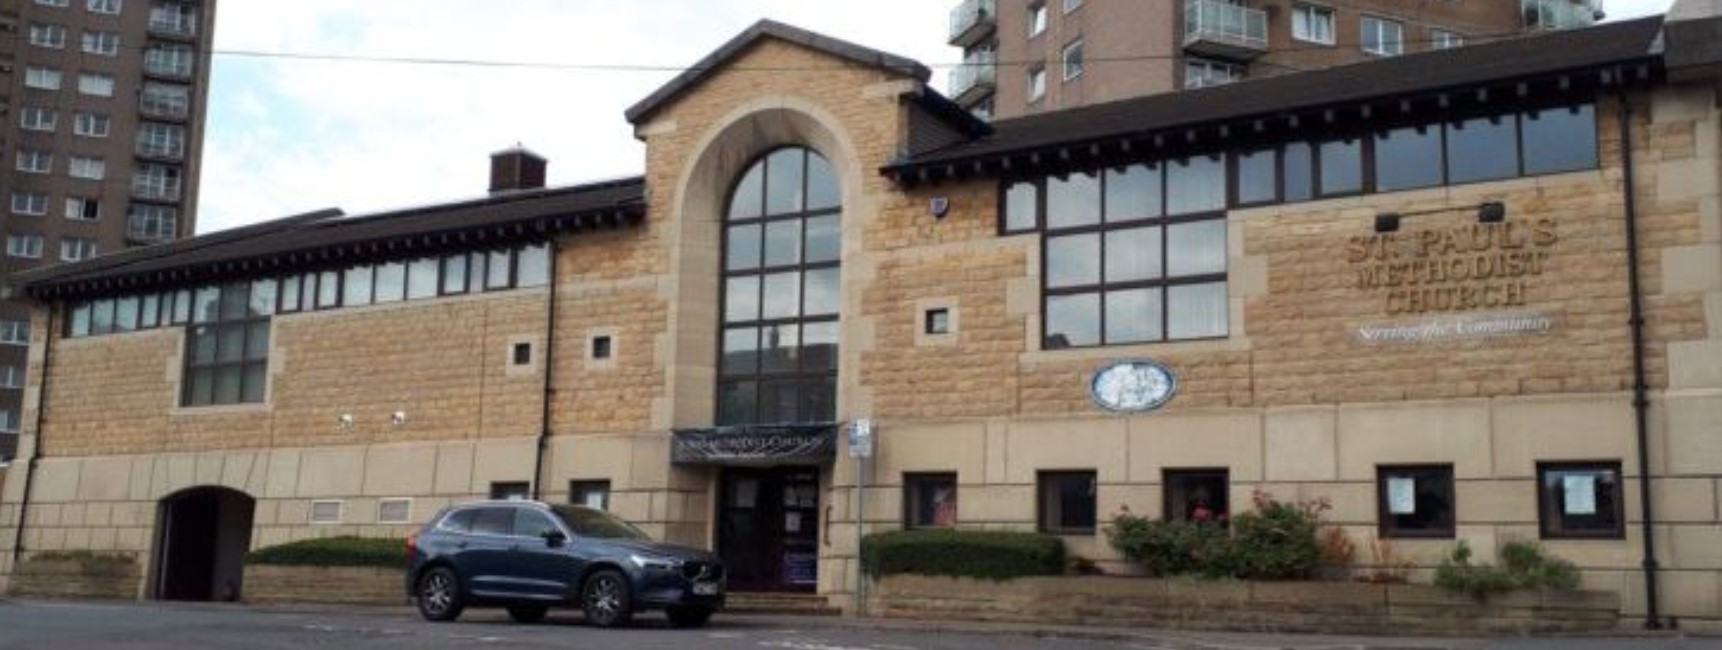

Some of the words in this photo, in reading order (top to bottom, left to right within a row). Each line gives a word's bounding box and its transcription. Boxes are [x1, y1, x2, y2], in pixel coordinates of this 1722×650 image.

[1347, 234, 1400, 263] ST.
[1415, 218, 1558, 257] PAUL'S
[1356, 252, 1548, 290] METHODIST
[1384, 281, 1527, 316] CHURCH
[1359, 325, 1419, 342] Serving
[1423, 321, 1445, 336] the
[1456, 313, 1550, 334] Community
